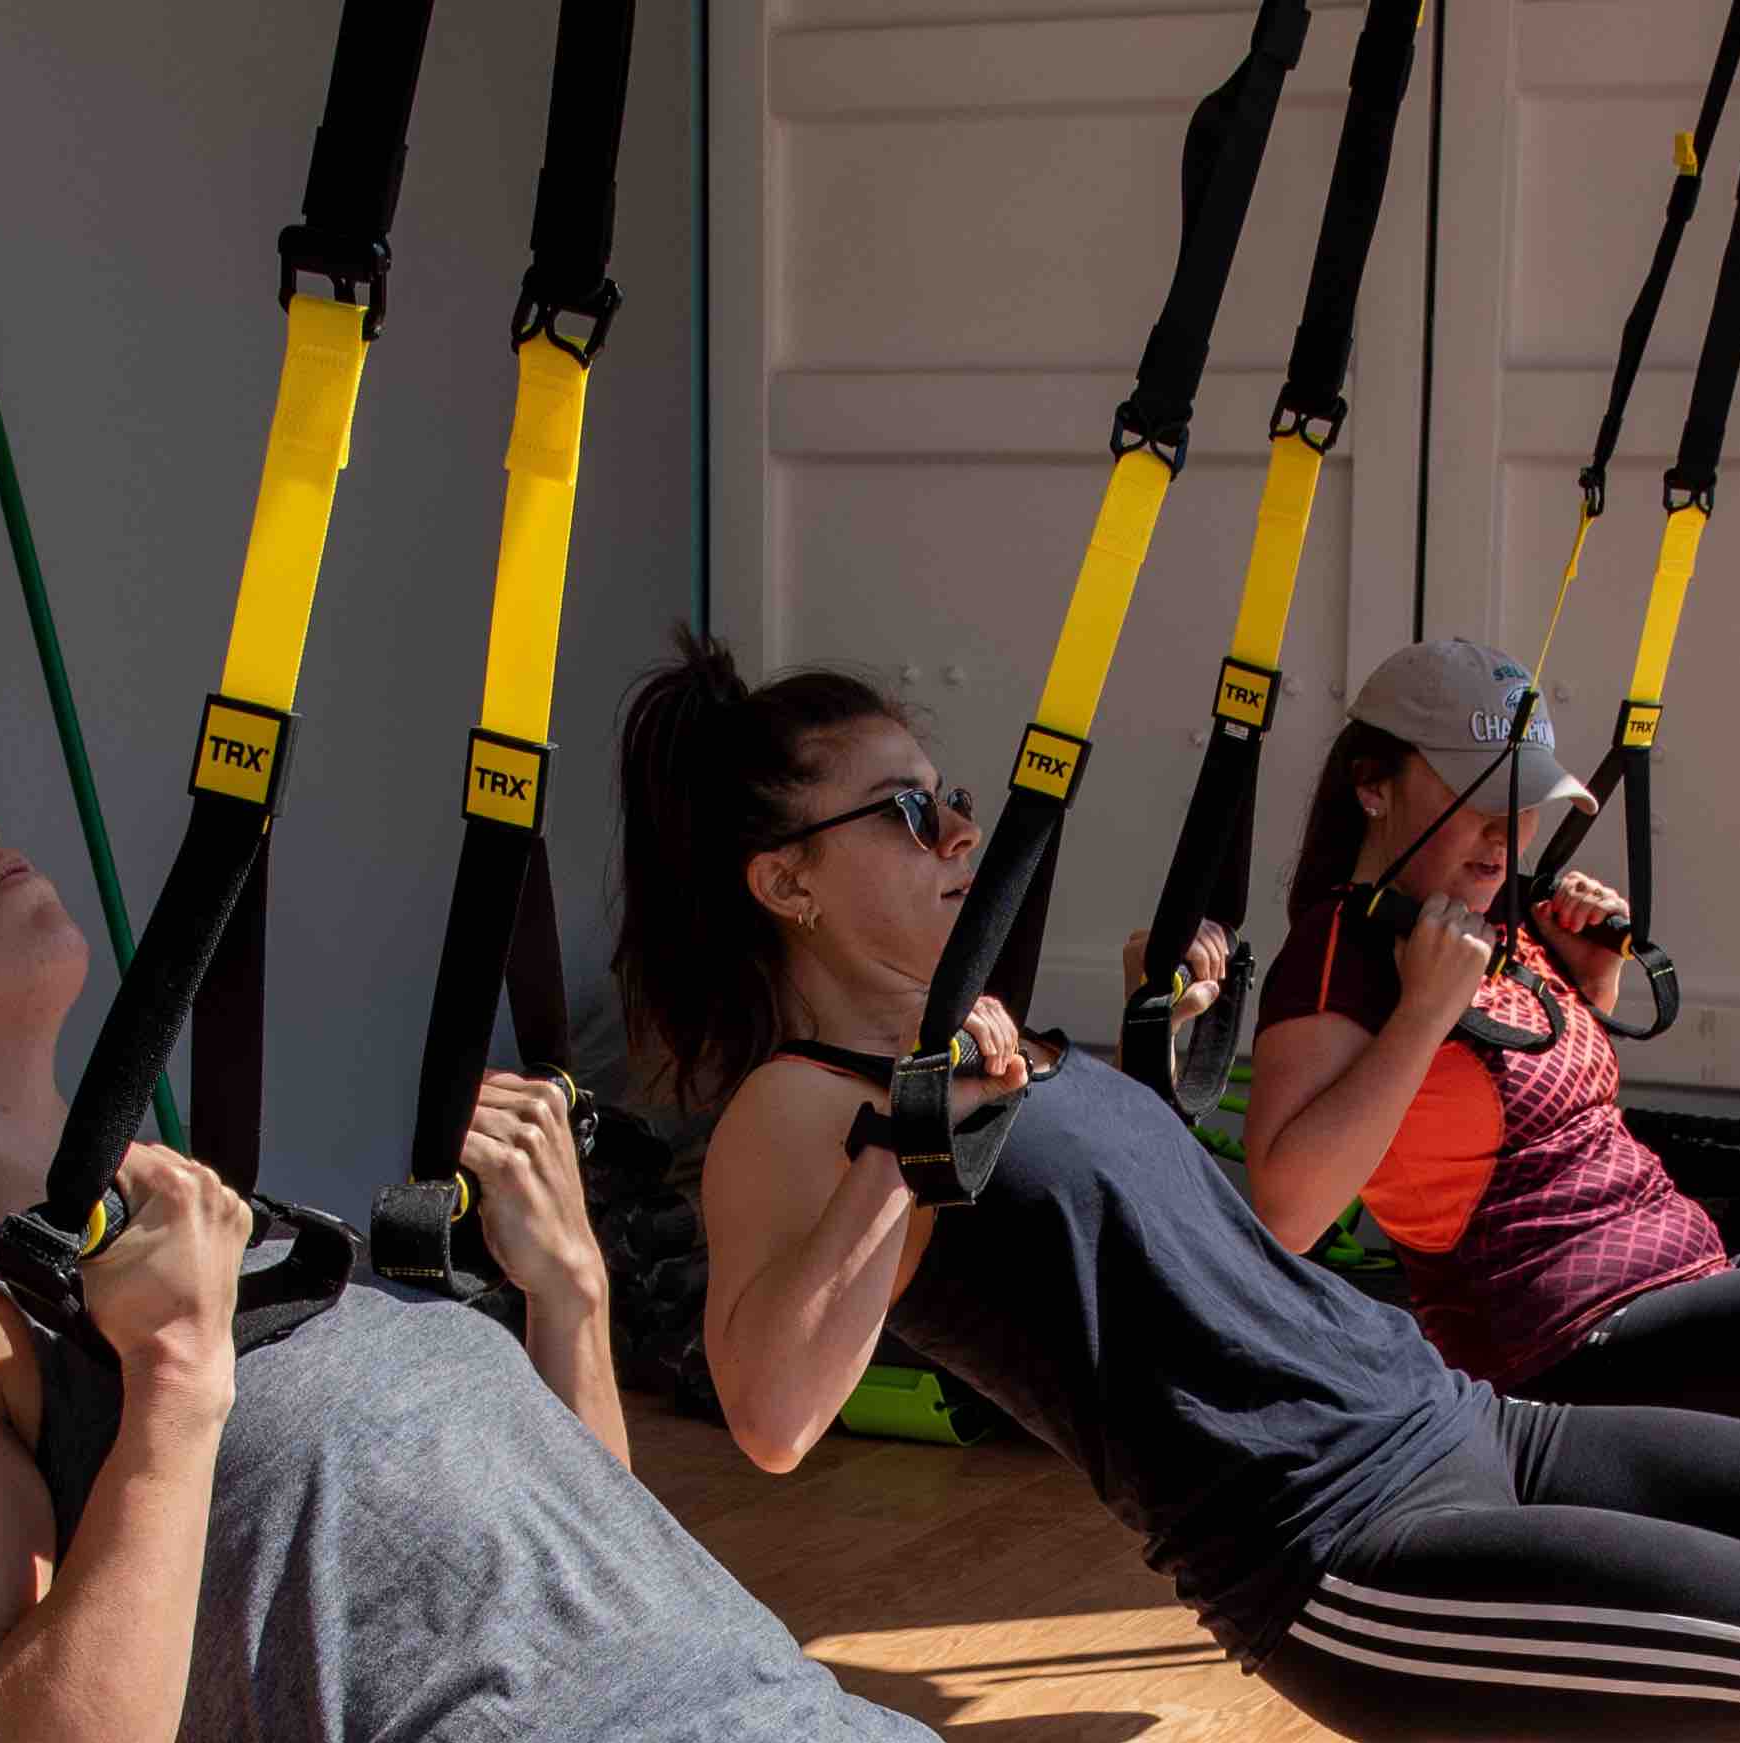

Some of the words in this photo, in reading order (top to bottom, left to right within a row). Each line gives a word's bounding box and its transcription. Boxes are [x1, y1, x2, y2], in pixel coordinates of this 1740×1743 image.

[1226, 682, 1263, 708] TRX
[1629, 719, 1655, 734] TRX
[209, 735, 269, 773] TRX
[1026, 750, 1071, 779] TRX
[475, 765, 533, 801] TRX
